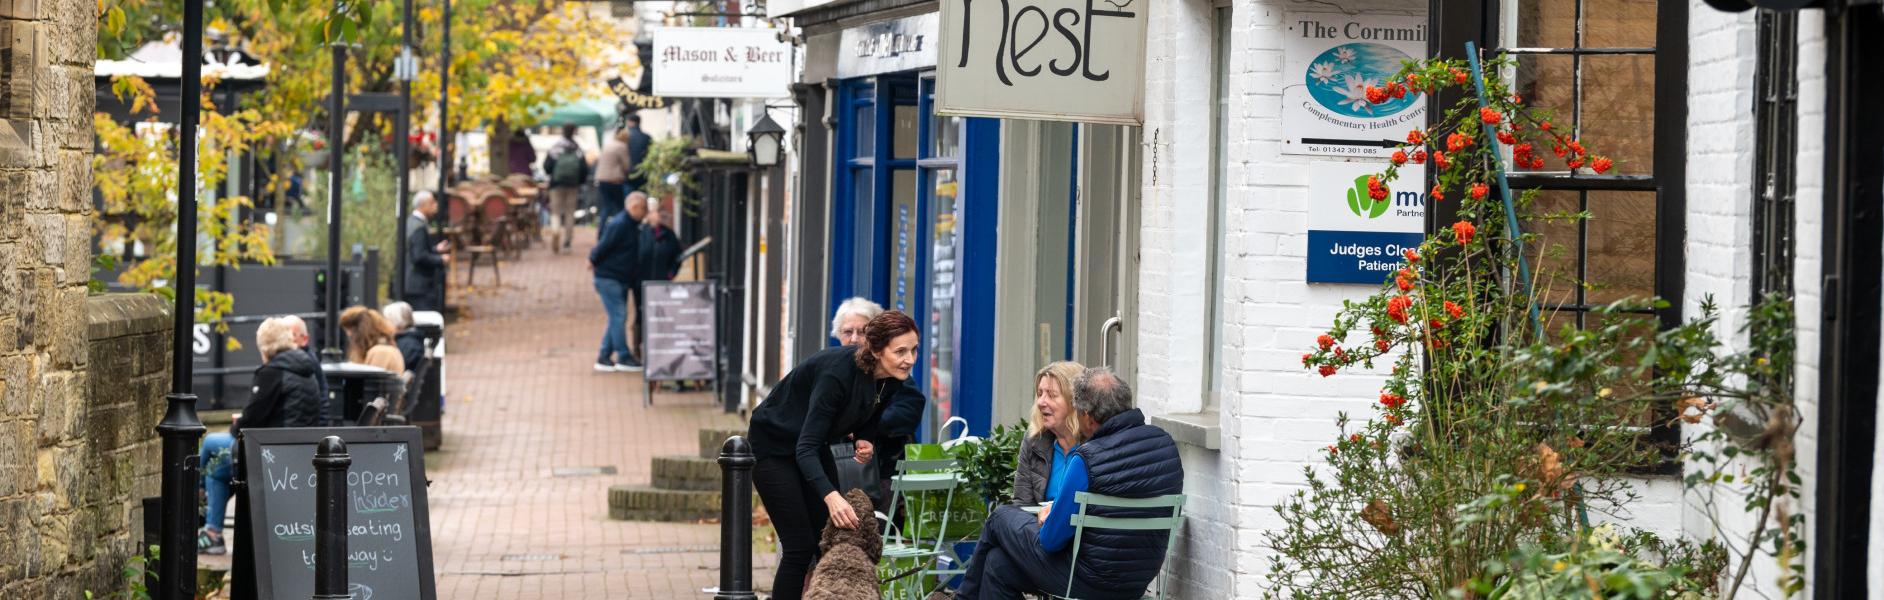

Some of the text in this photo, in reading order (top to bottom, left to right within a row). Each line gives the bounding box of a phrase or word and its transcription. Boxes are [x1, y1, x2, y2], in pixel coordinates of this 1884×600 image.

[1299, 20, 1337, 38] The
[662, 45, 783, 63] Mason & Beer
[614, 81, 664, 108] SPORTS
[1302, 101, 1367, 131] Complementary
[1369, 119, 1398, 131] Health
[1330, 243, 1381, 258] Judges
[268, 466, 299, 492] We
[347, 470, 399, 496] open
[274, 520, 316, 536] outsi
